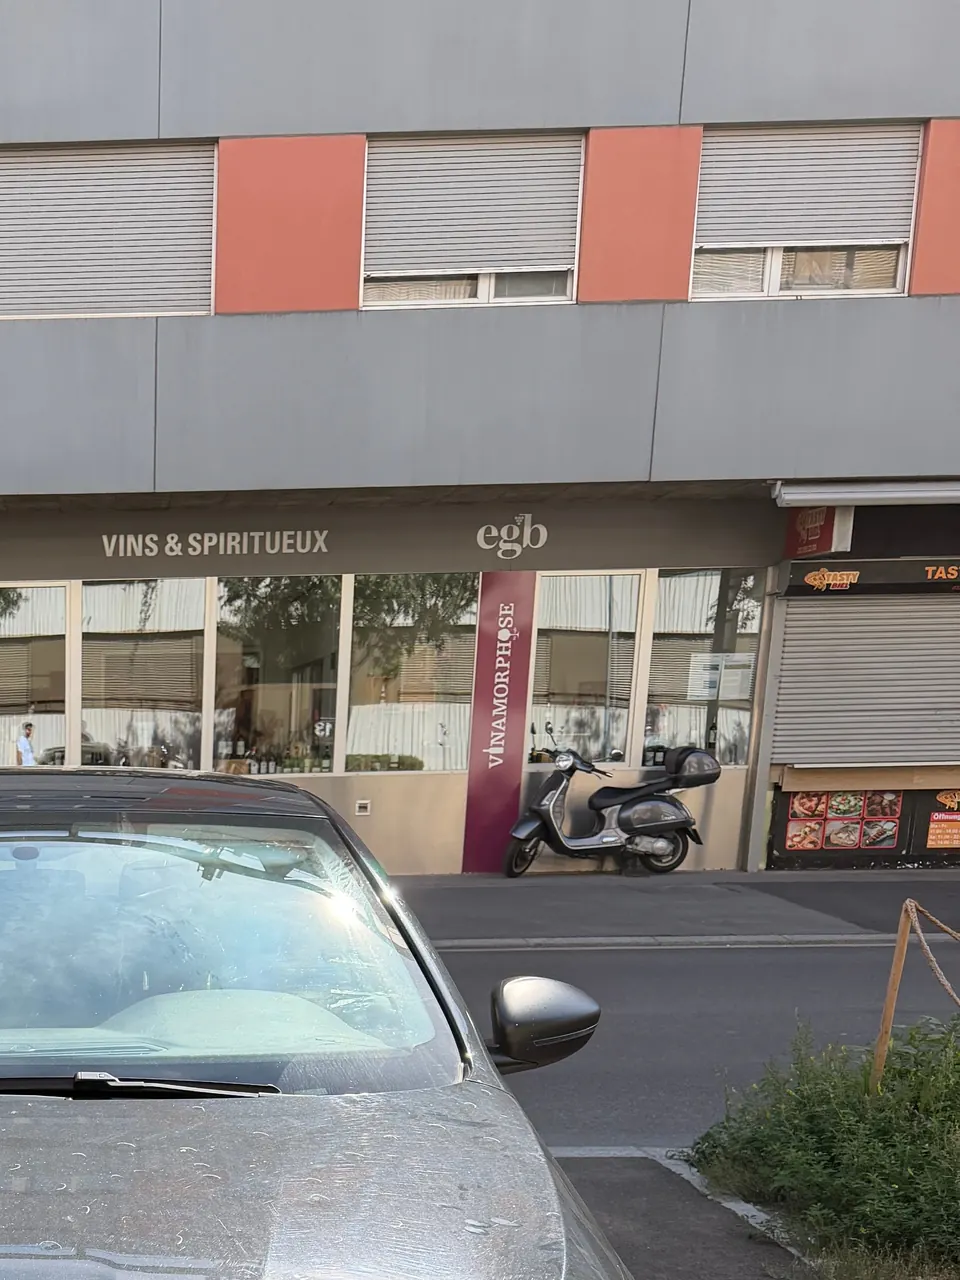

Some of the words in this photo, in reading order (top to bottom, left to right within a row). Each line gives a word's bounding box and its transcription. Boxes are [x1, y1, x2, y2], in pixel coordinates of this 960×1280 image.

[101, 534, 159, 557] VINS
[164, 533, 183, 556] &
[187, 530, 329, 556] SPIRITUEUX
[476, 513, 548, 560] egb
[825, 572, 859, 583] TASTY
[925, 565, 960, 580] TAS
